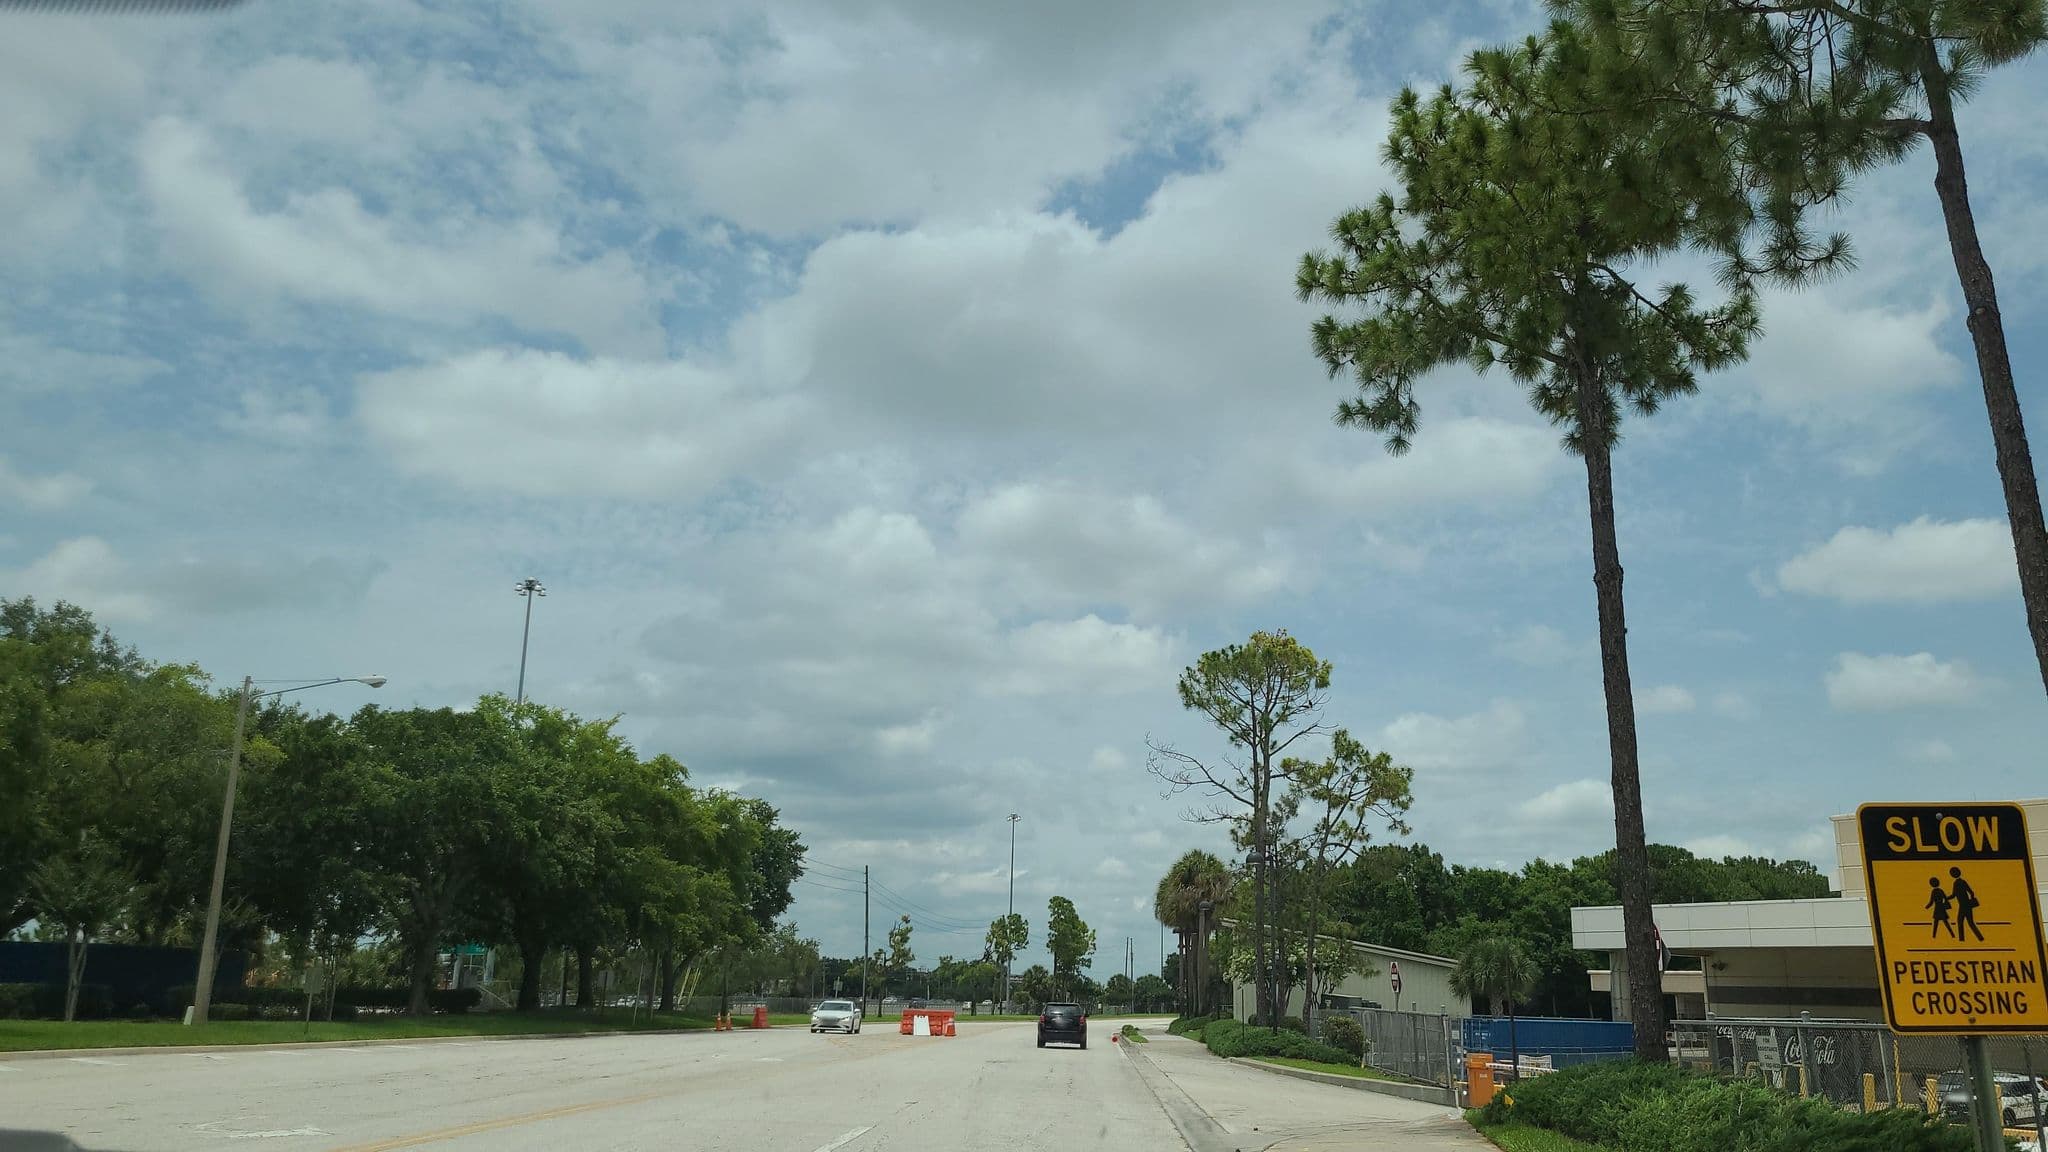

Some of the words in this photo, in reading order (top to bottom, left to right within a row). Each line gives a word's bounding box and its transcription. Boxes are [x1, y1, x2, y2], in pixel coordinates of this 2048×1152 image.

[1886, 816, 1999, 852] SLOW
[1894, 960, 2036, 984] PEDESTRIAN
[1912, 991, 2028, 1015] CROSSING
